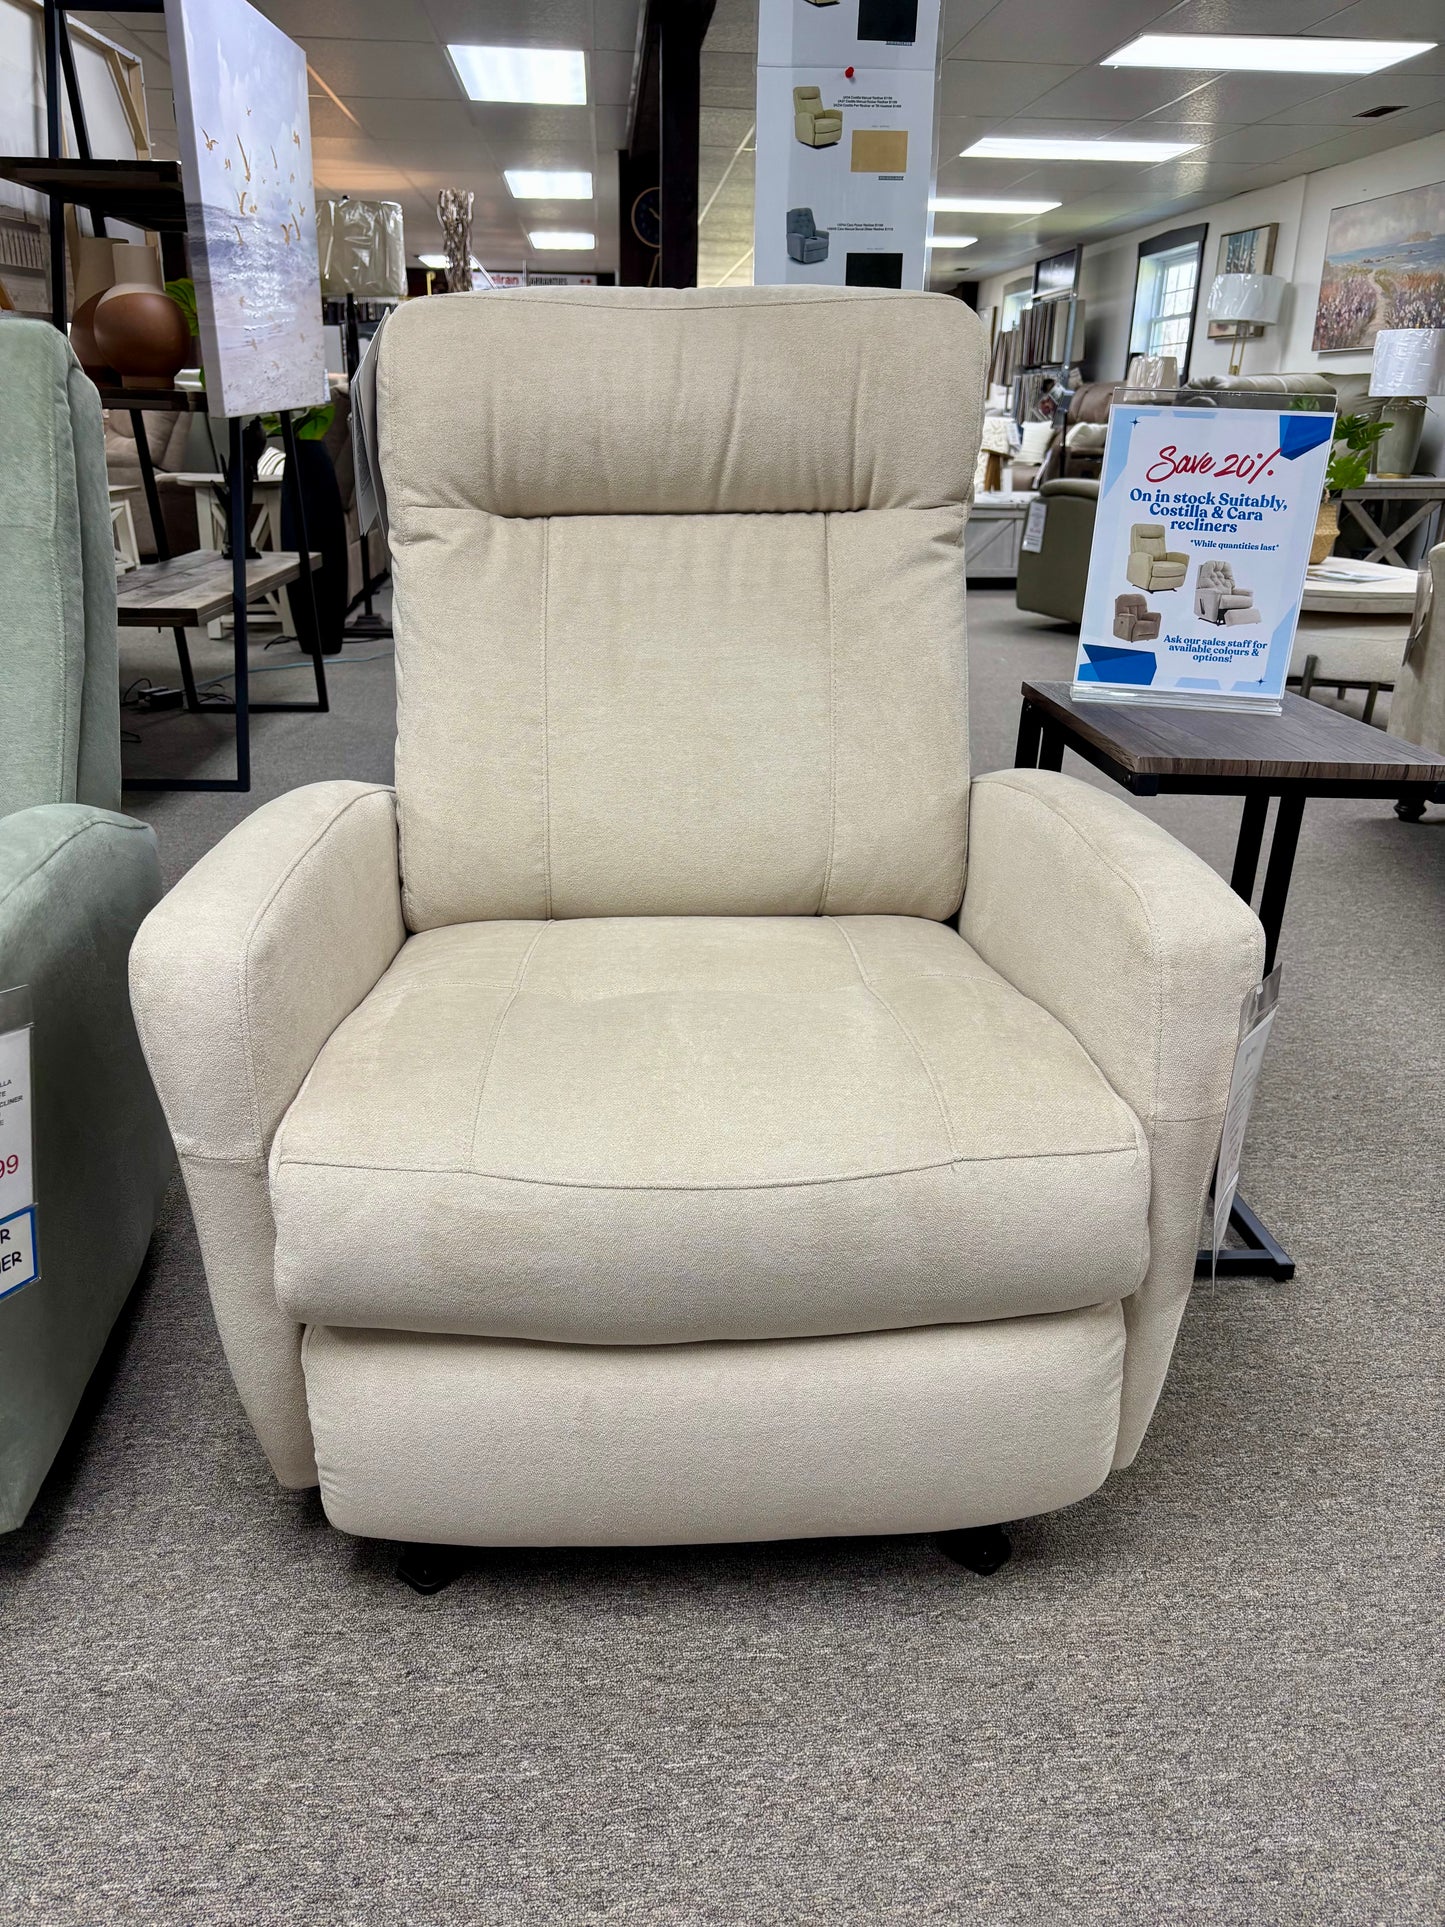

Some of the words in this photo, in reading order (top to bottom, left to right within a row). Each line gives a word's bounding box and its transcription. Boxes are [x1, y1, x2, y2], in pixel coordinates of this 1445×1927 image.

[1146, 445, 1216, 483] Save
[1213, 447, 1282, 485] 20%
[1130, 488, 1151, 501] On
[1155, 489, 1170, 503] in
[1173, 491, 1215, 505] stock
[1218, 493, 1287, 511] Suitably,
[1149, 502, 1207, 518] Costilla
[1211, 505, 1223, 519] &
[1227, 506, 1263, 521] Cara
[1170, 517, 1237, 533] recliners
[1218, 542, 1259, 550] quantities
[1163, 634, 1182, 644] Ask
[1183, 637, 1201, 645] our
[1202, 638, 1226, 647] sales
[1227, 639, 1253, 648] staff
[1253, 640, 1268, 649] for
[1168, 644, 1212, 654] available
[1213, 646, 1249, 656] colours
[1192, 653, 1233, 663] options!
